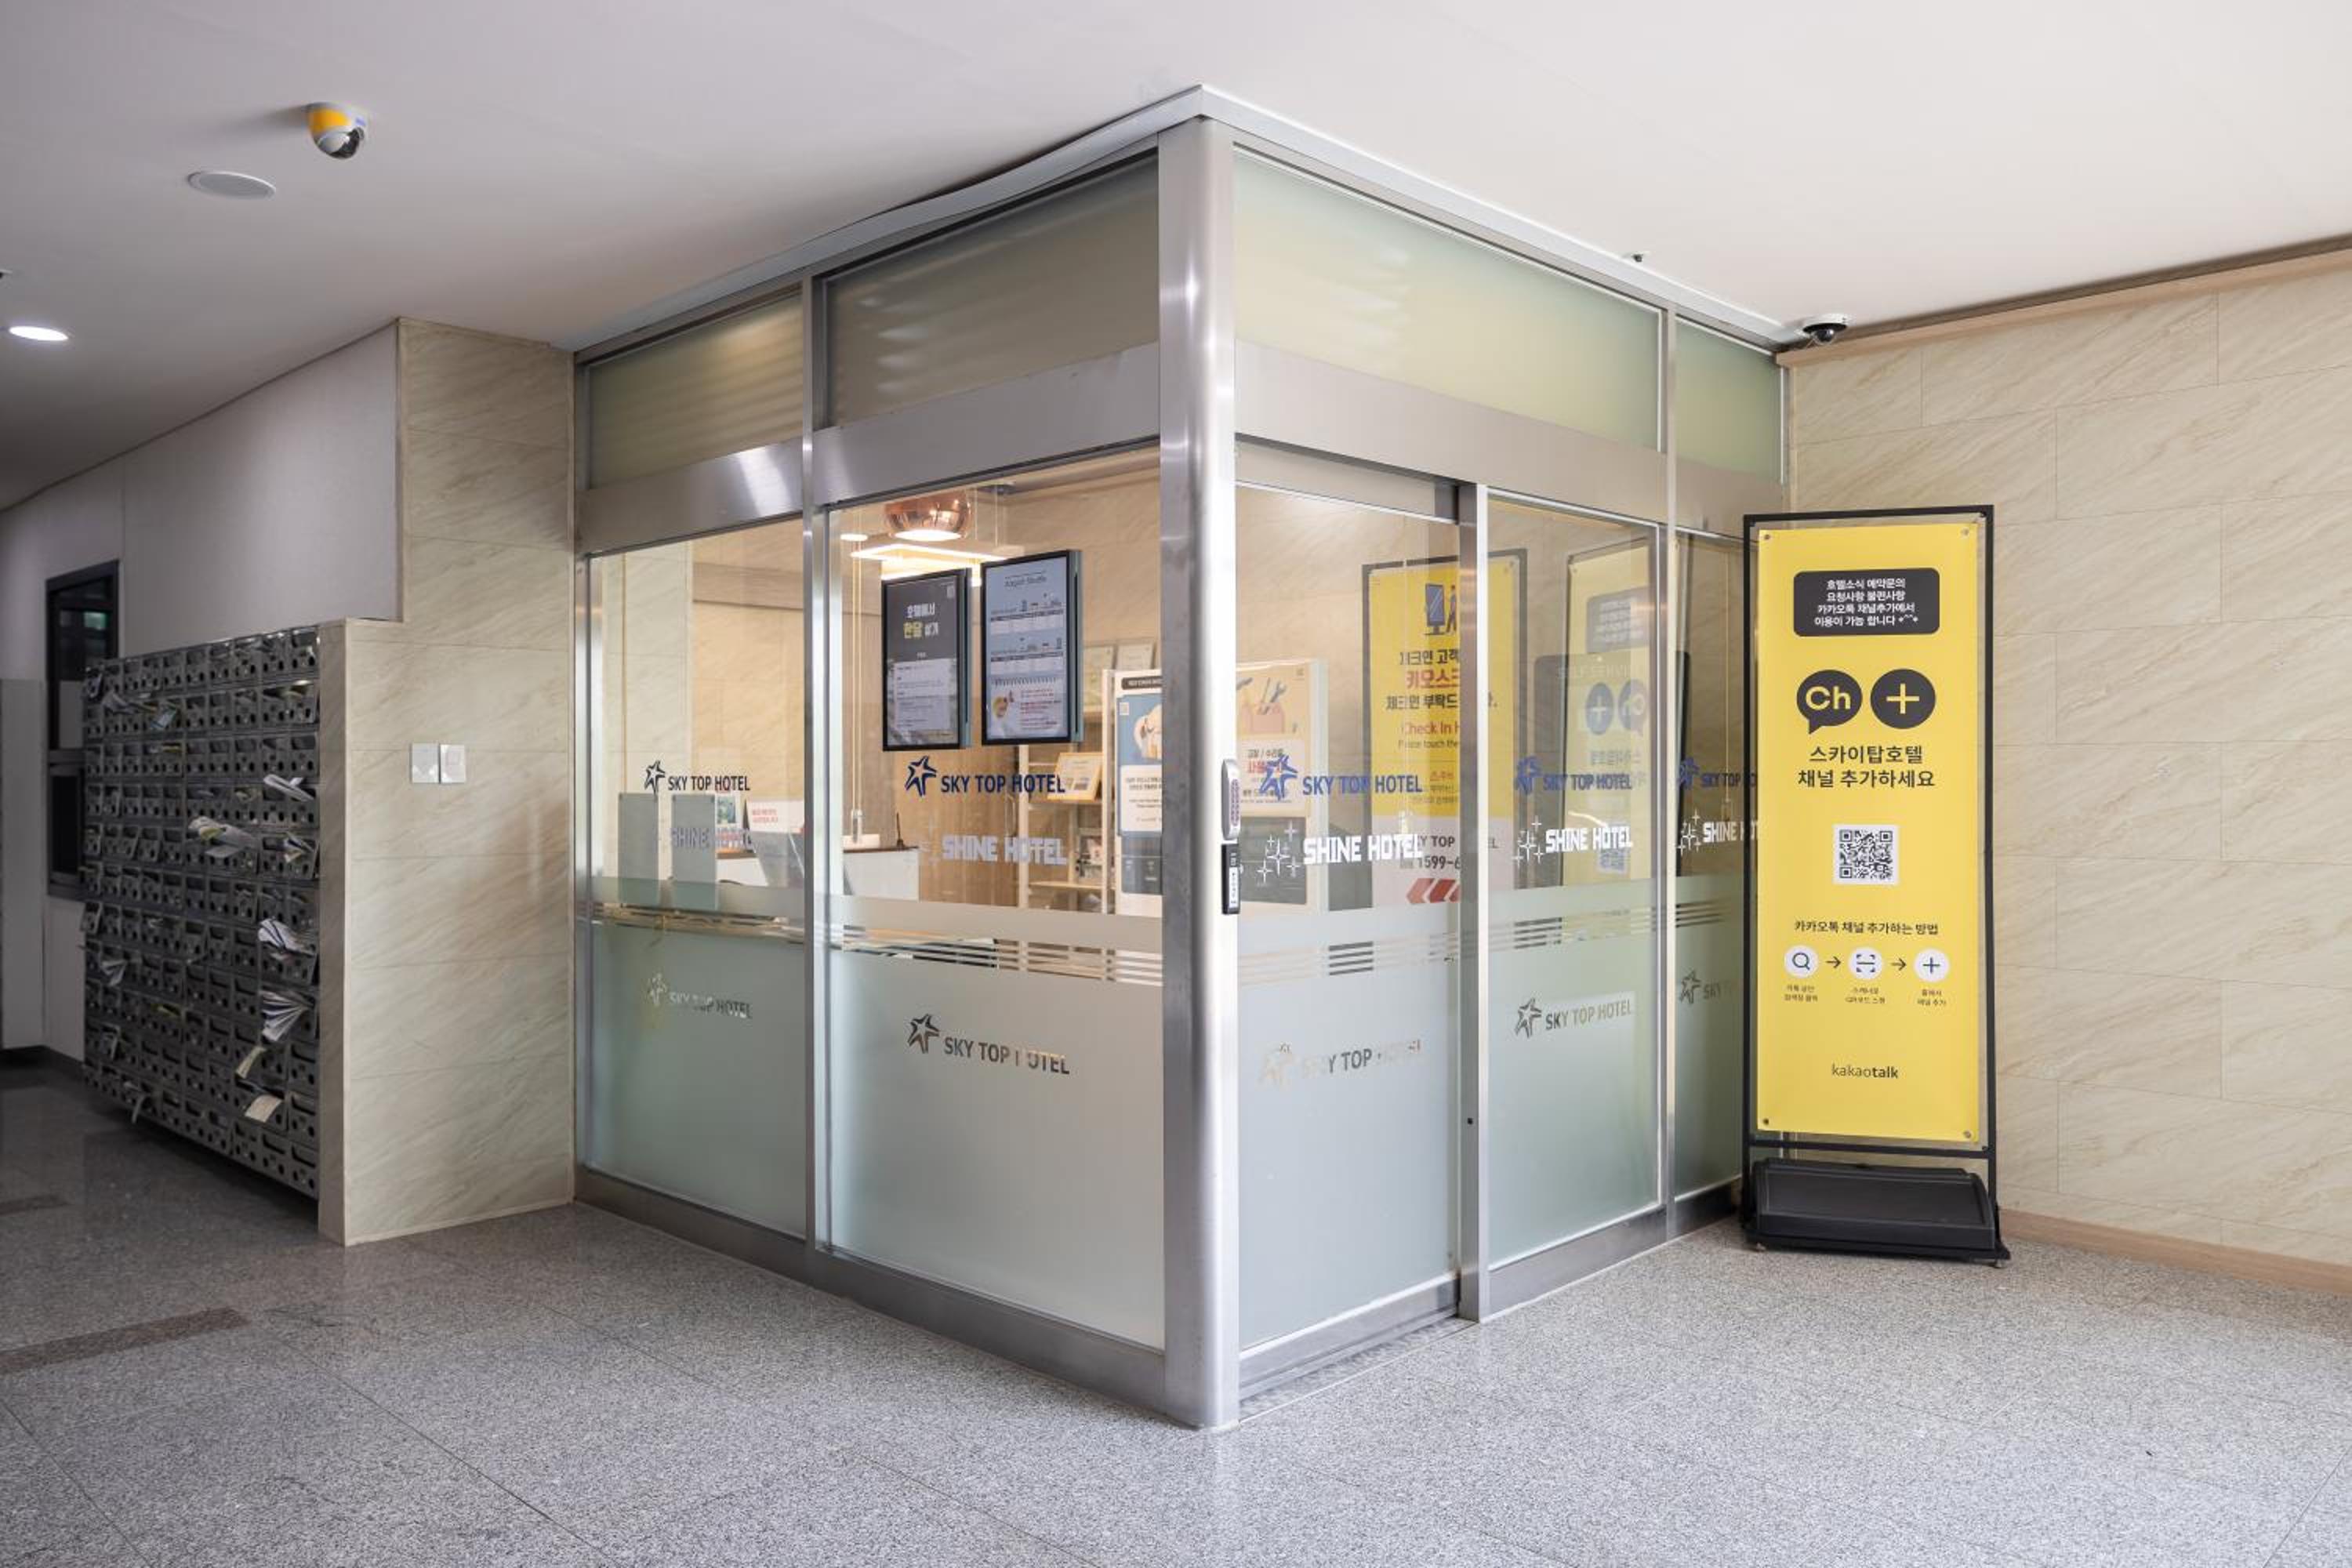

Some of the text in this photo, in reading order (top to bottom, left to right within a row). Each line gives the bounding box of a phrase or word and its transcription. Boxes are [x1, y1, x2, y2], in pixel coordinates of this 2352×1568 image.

[1827, 578, 1906, 590] 호텔소식 예약문의
[1827, 590, 1905, 602] 요청사항 불편사항
[1817, 603, 1855, 614] 카카오톡
[1814, 615, 1843, 626] 이용이
[1845, 615, 1864, 626] 가능
[1806, 685, 1852, 711] Ch
[1809, 746, 1923, 764] 스카이탑호텔
[668, 775, 750, 791] SKY TOP HOTEL
[942, 774, 1065, 793] SKY TOP HOTEL
[1302, 775, 1334, 795] SKY
[1338, 775, 1370, 794] TOP
[1375, 775, 1423, 793] HOTEL
[1570, 774, 1594, 790] TOP
[1596, 773, 1632, 789] HOTEL
[1798, 769, 1936, 788] 채널 추가하세요
[1545, 826, 1633, 853] SHINE HOTEL
[1703, 821, 1737, 843] SHINE
[943, 834, 1067, 866] SHINE HOTEL
[1303, 836, 1362, 865] SHINE
[1367, 834, 1423, 861] HOTEL
[1431, 835, 1455, 848] TOP
[1417, 855, 1461, 869] 1599-6
[1794, 920, 1939, 935] 카카오톡 채널 추가하는 방법
[1546, 999, 1632, 1030] SKY TOP HOTEL
[944, 1036, 975, 1058] SKY
[978, 1042, 1011, 1064] TOP
[1341, 1048, 1372, 1071] TOP
[1831, 1063, 1898, 1079] kakaotalk
